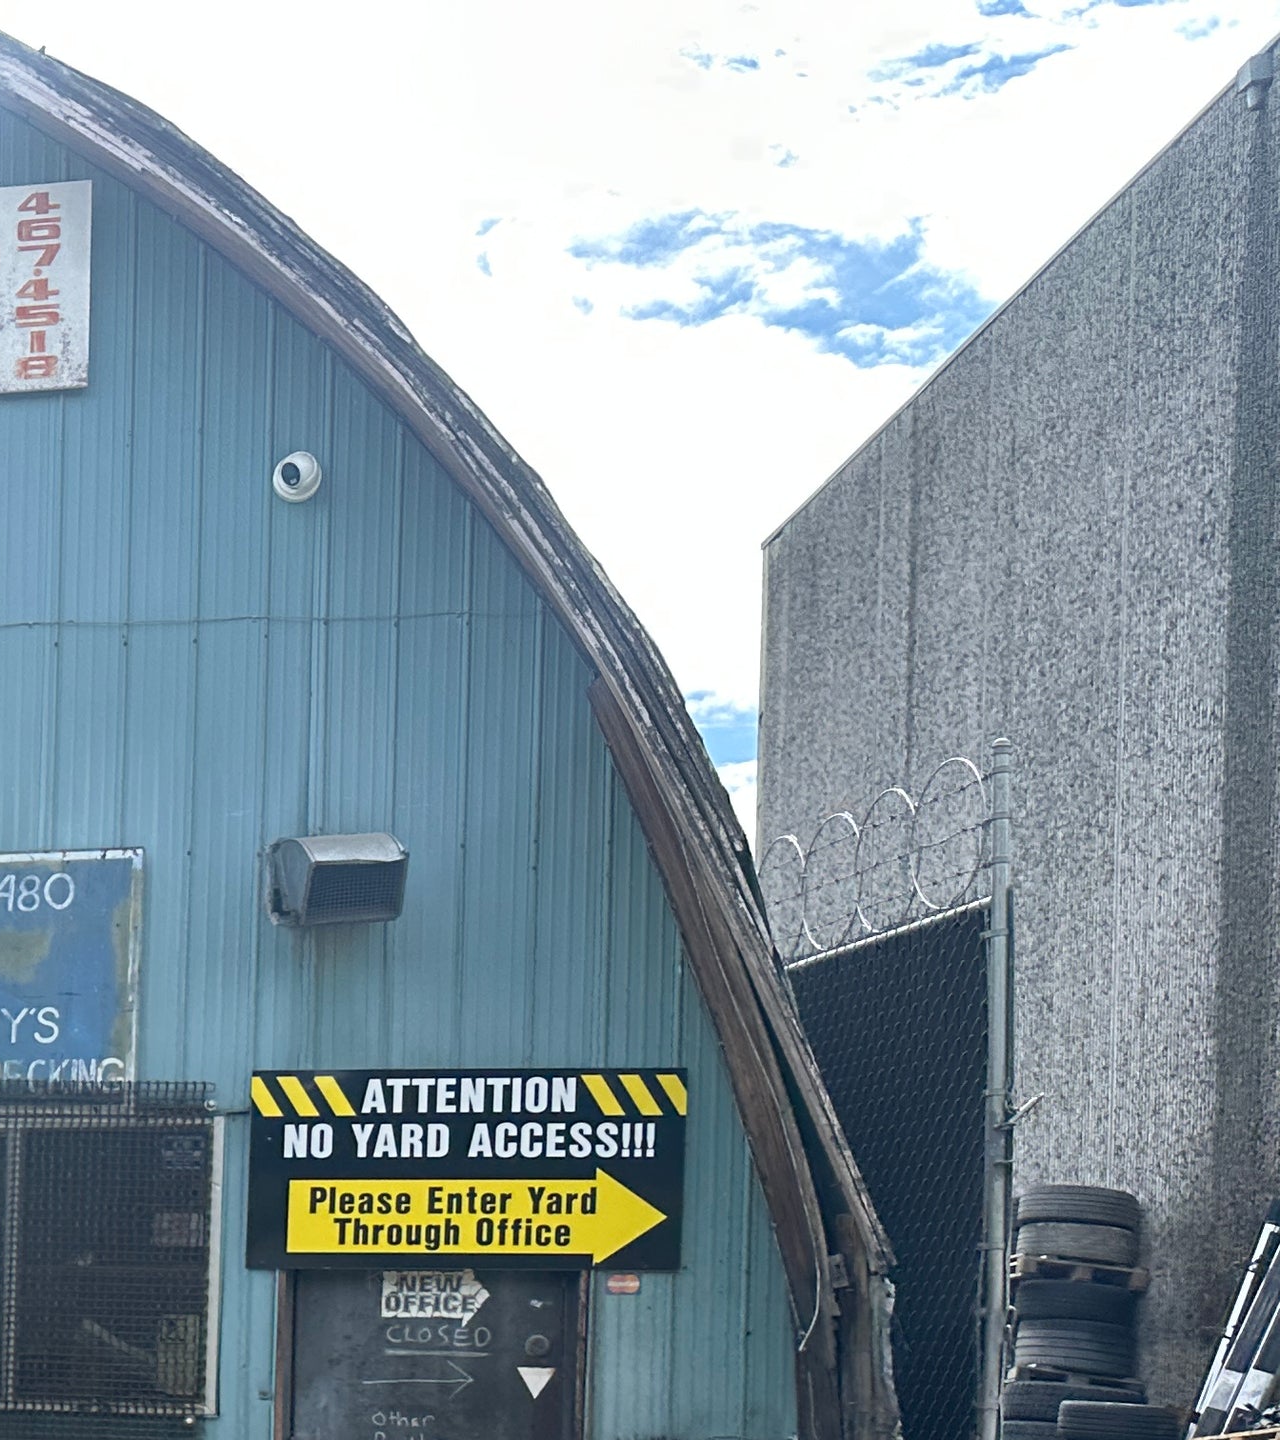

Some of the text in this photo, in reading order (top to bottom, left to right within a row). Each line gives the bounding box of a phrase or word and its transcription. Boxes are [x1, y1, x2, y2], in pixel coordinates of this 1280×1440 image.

[361, 1076, 578, 1114] ATTENTION
[283, 1121, 657, 1159] NO YARD ACCESS!!!
[309, 1187, 598, 1215] Please Enter Yard
[334, 1217, 572, 1251] Through Office
[400, 1272, 461, 1292] NEW
[384, 1291, 477, 1313] OFFICE
[386, 1324, 491, 1347] CLOSED
[372, 1411, 435, 1427] Other
